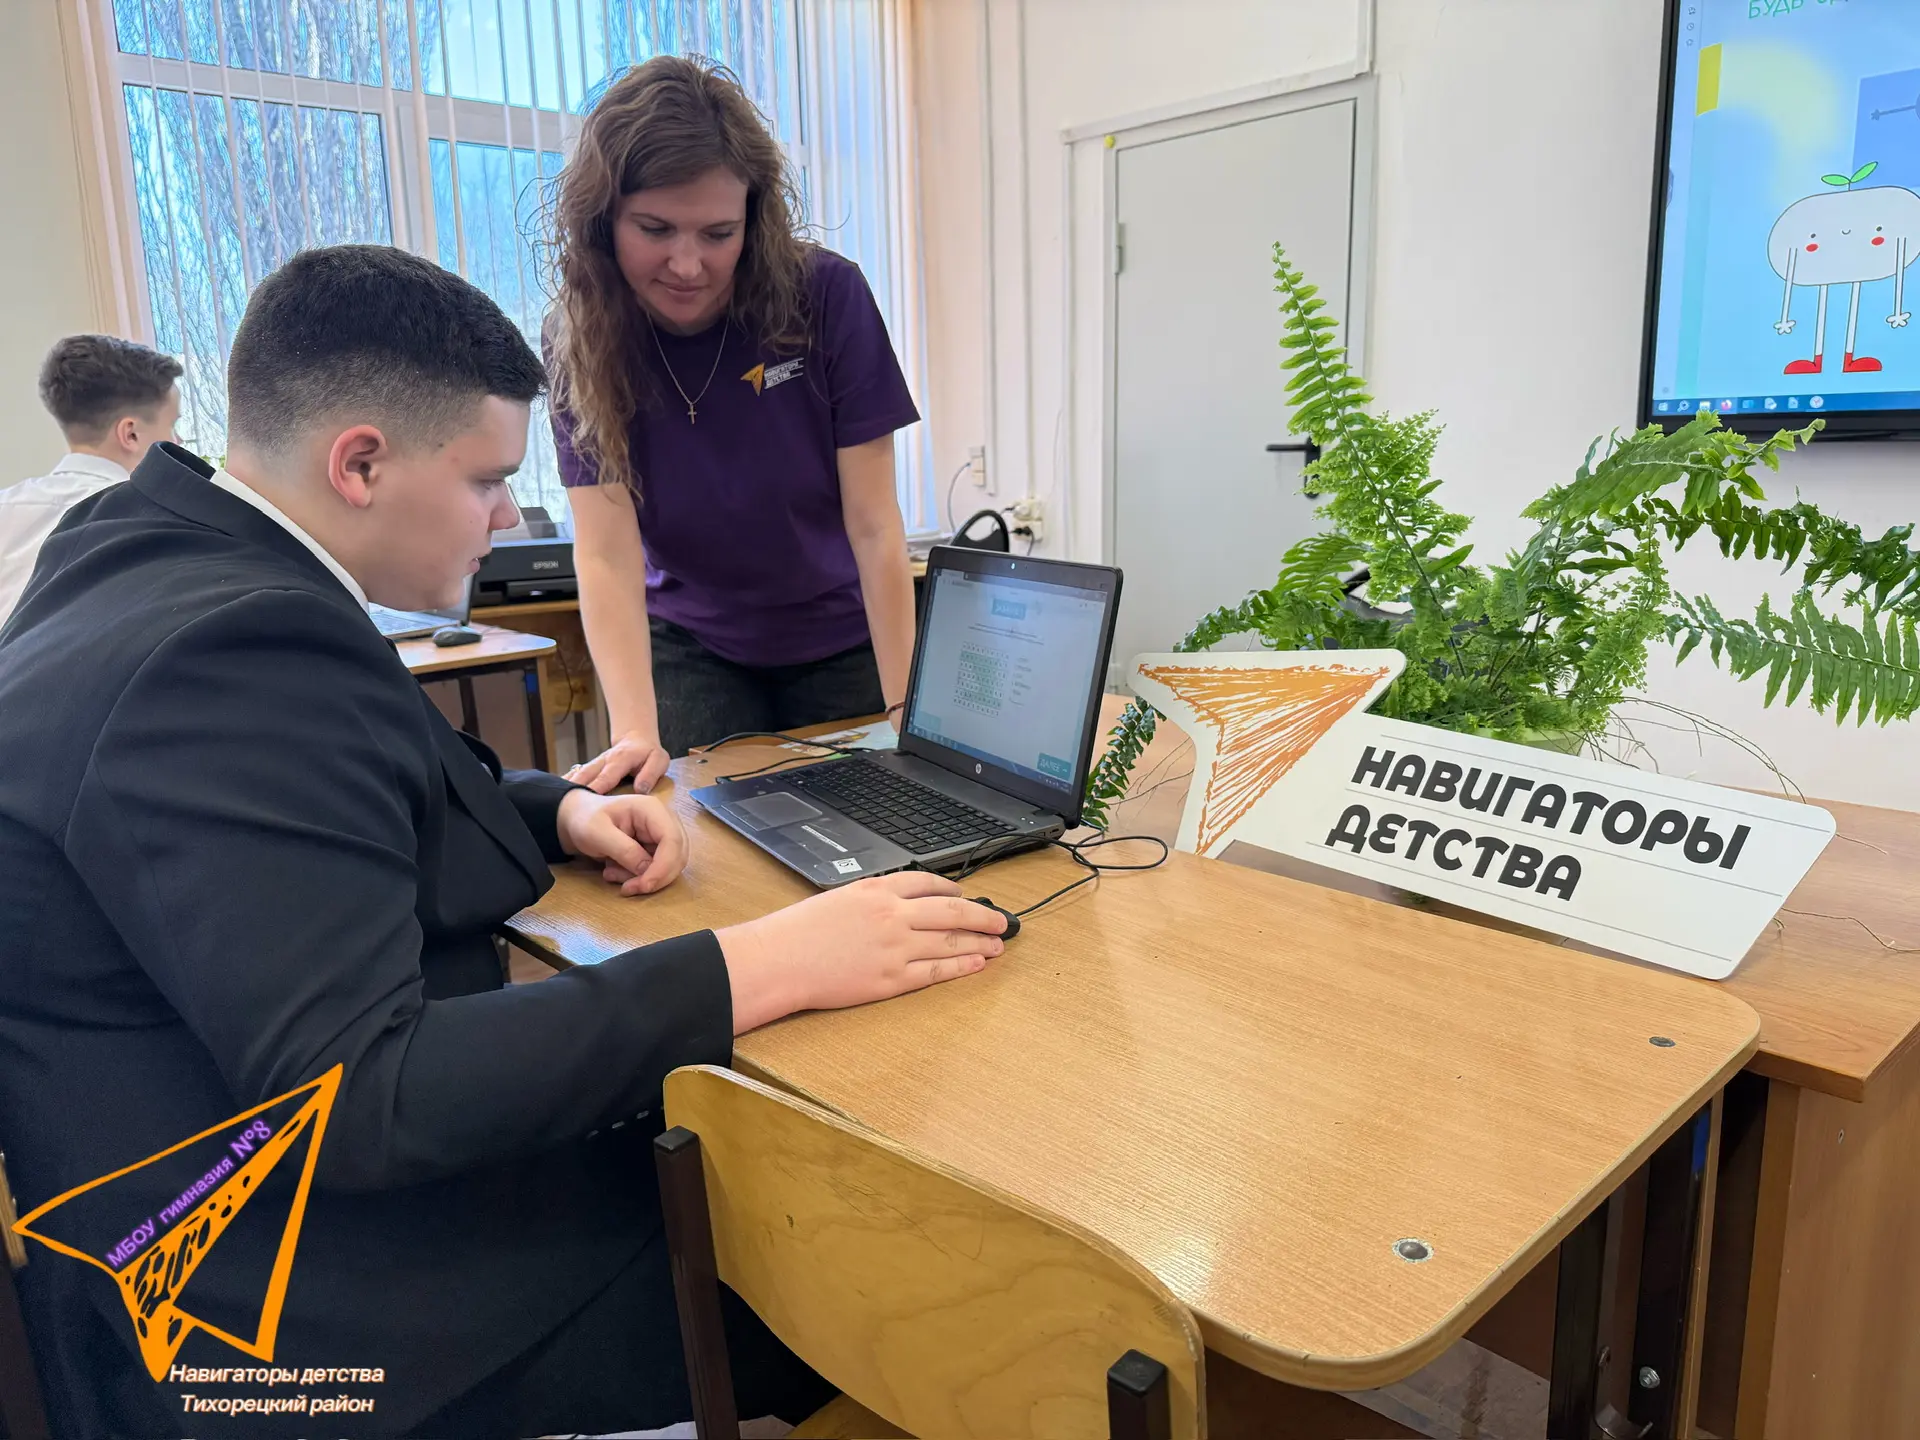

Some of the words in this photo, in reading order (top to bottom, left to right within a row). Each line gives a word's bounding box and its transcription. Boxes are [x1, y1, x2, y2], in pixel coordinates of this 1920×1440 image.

[533, 560, 559, 570] EPSON
[1324, 804, 1582, 901] ДЕТСТВА
[1350, 745, 1752, 870] НАВИГАТОРЫ
